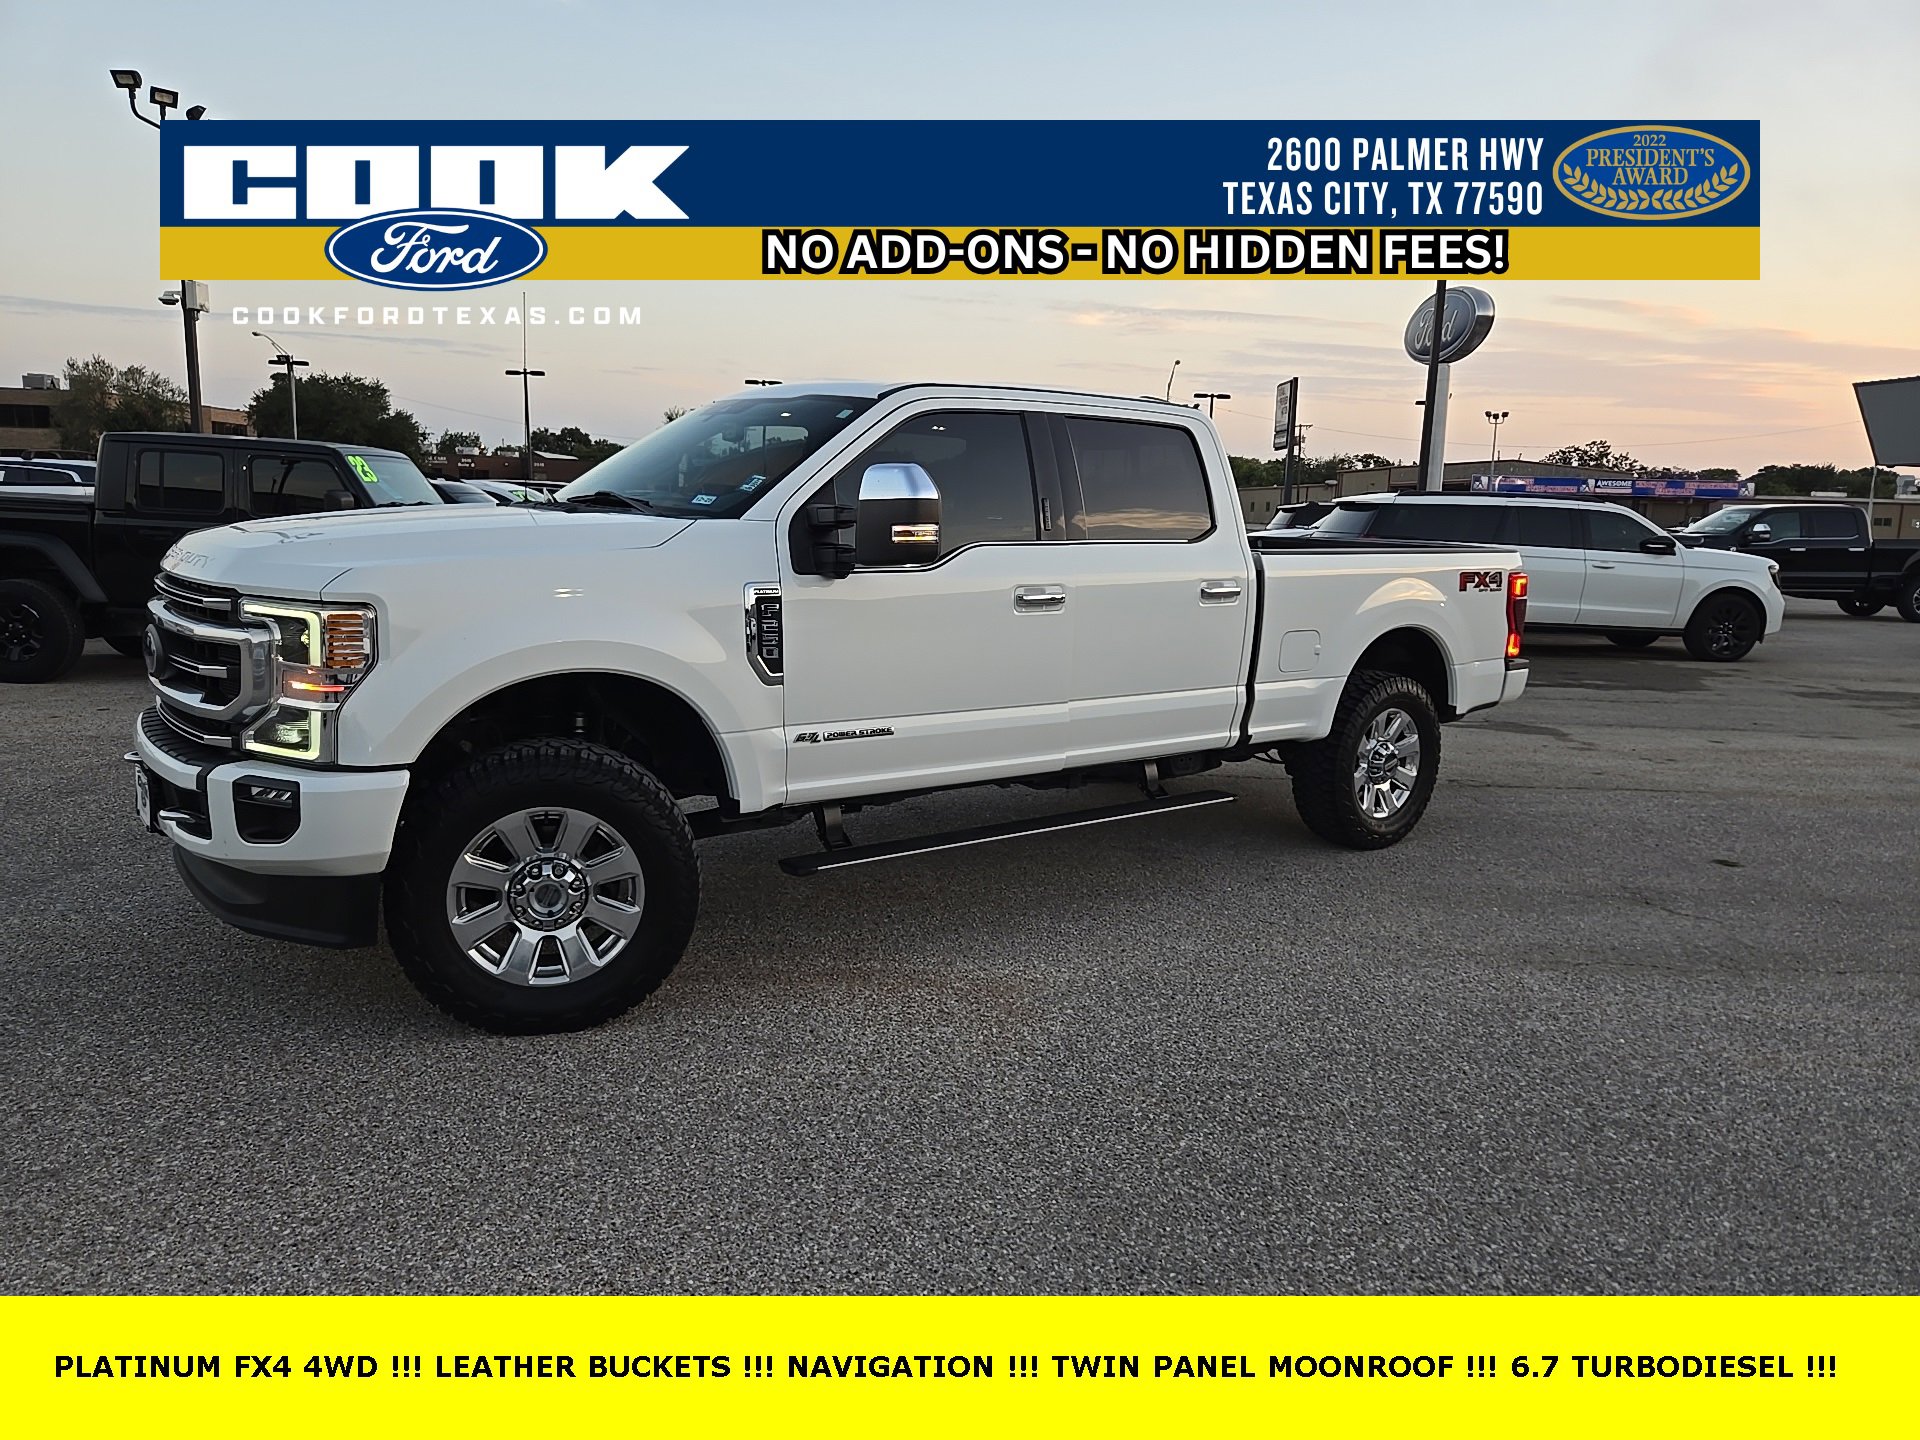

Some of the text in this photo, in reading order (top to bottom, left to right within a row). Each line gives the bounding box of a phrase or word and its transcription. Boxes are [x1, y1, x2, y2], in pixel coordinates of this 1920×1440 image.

[347, 455, 378, 482] 23
[1596, 480, 1632, 488] AWESOME
[1458, 571, 1503, 592] FX4
[826, 730, 857, 739] POWER
[859, 726, 893, 736] STROKE
